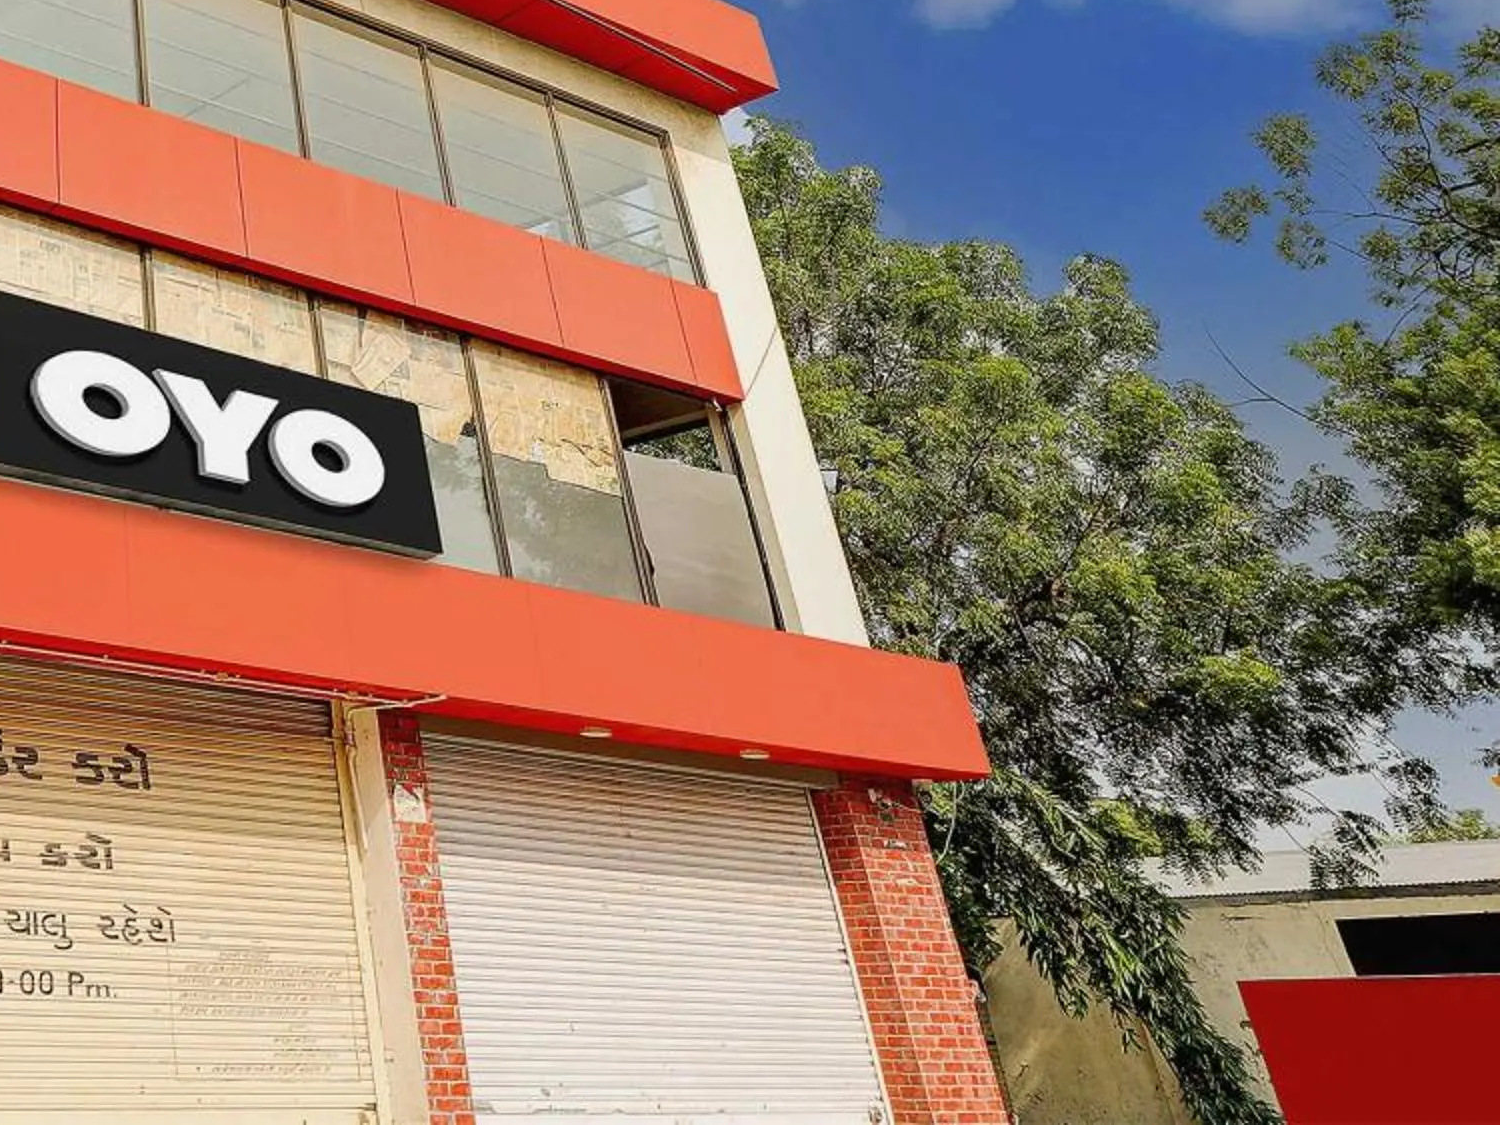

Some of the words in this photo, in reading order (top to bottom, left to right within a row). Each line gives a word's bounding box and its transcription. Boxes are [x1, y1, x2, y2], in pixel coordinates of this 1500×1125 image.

[30, 349, 385, 507] OYO
[71, 743, 151, 790] કરો
[39, 831, 113, 870] કરો
[3, 908, 73, 950] ચાલુ
[97, 904, 176, 945] રહેશે
